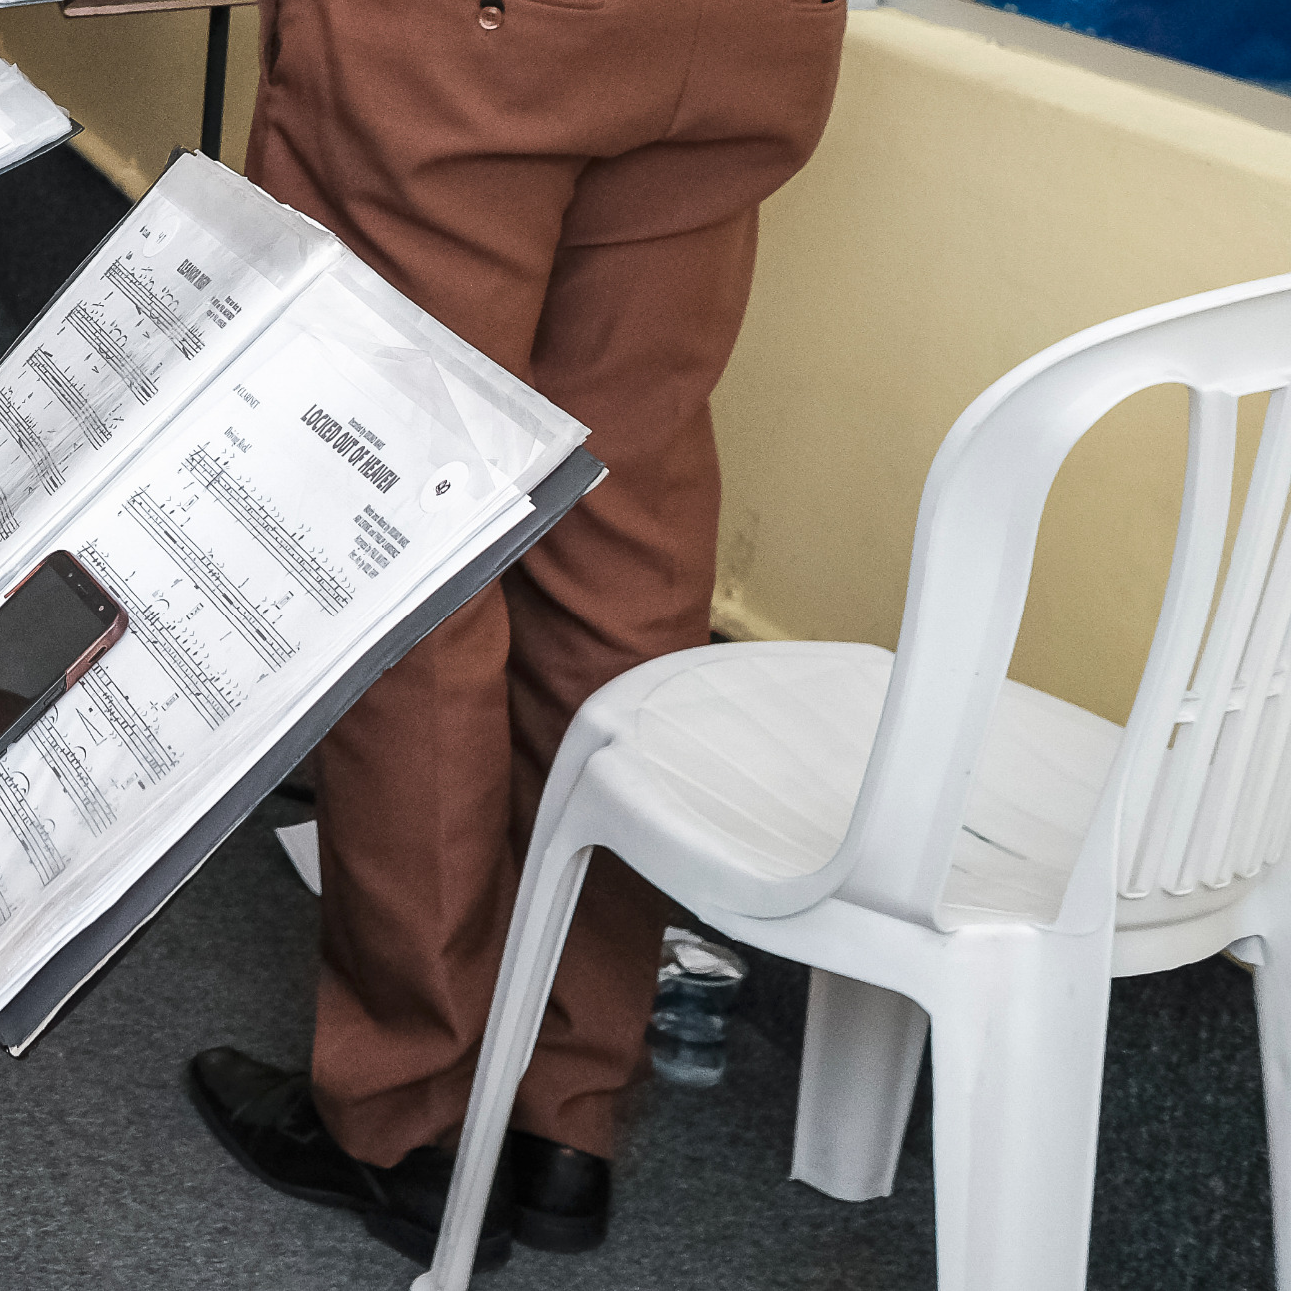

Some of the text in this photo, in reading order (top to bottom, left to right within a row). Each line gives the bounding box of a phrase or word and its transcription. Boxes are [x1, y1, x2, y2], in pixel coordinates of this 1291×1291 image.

[300, 404, 343, 444] LOCKED
[333, 432, 360, 458] OUT
[348, 446, 371, 467] OF
[358, 455, 401, 495] HEAVEN
